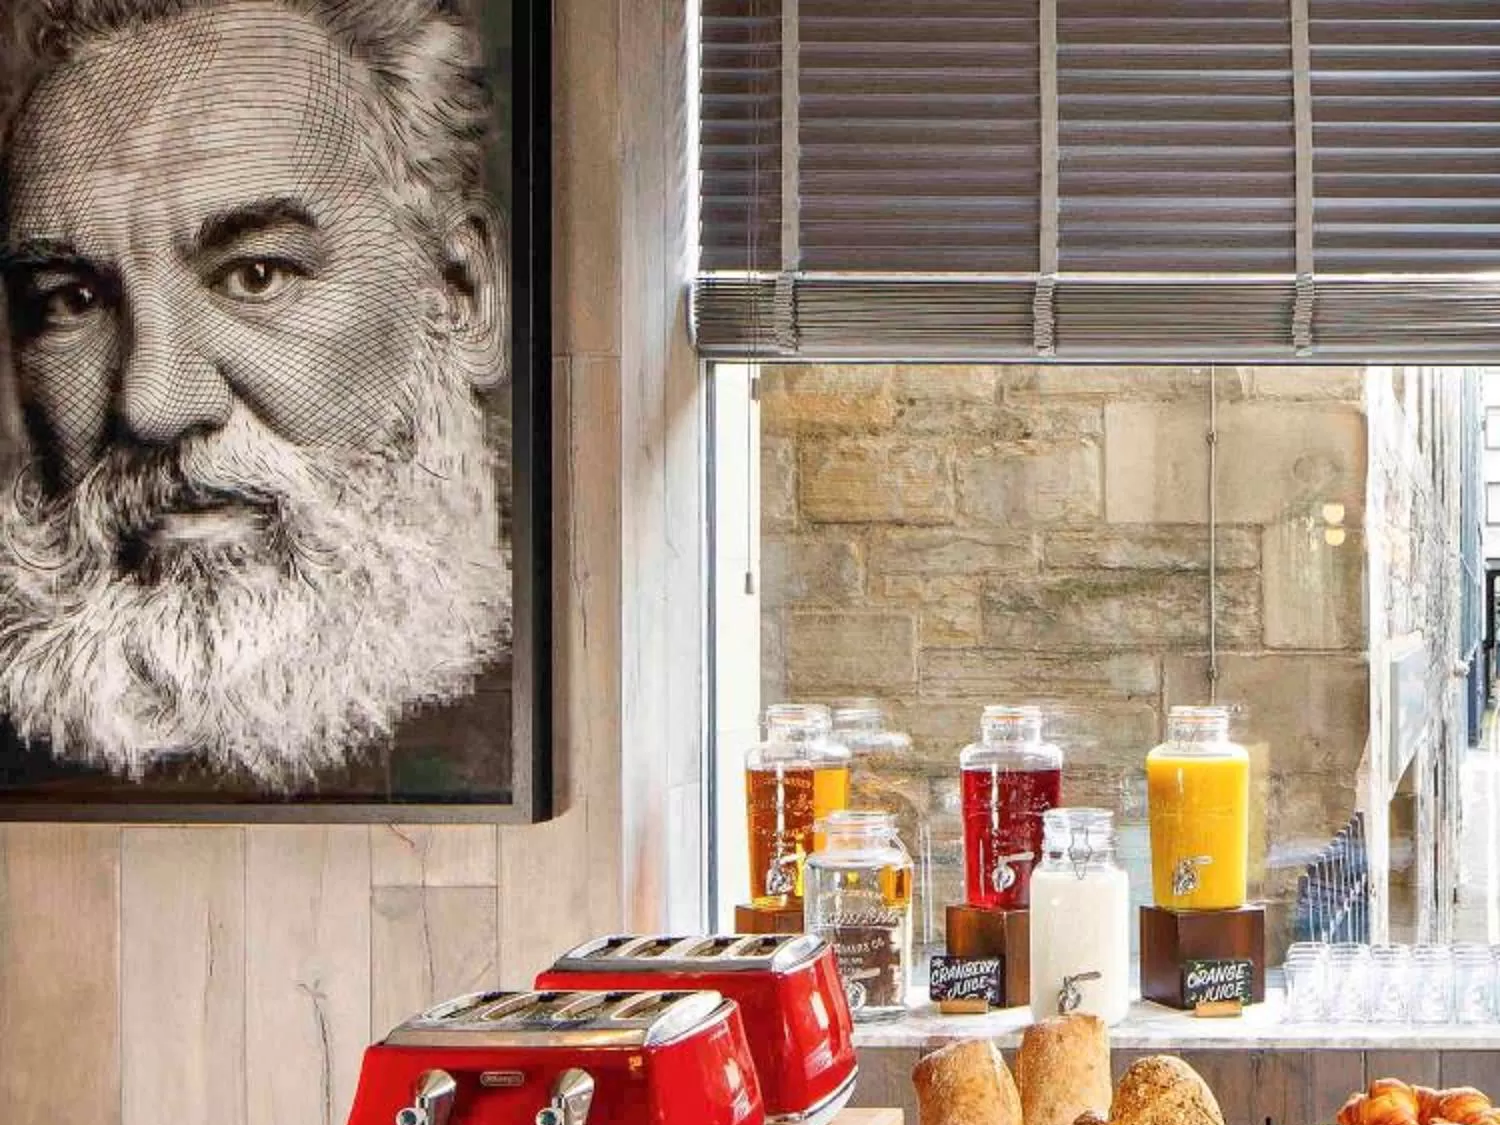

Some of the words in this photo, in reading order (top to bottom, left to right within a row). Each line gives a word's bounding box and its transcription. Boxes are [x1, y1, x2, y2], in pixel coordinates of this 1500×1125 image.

[931, 959, 999, 986] CRANBERRY
[1187, 962, 1248, 989] ORANGE
[947, 975, 988, 1001] JUICE
[1199, 980, 1245, 1004] JUICE
